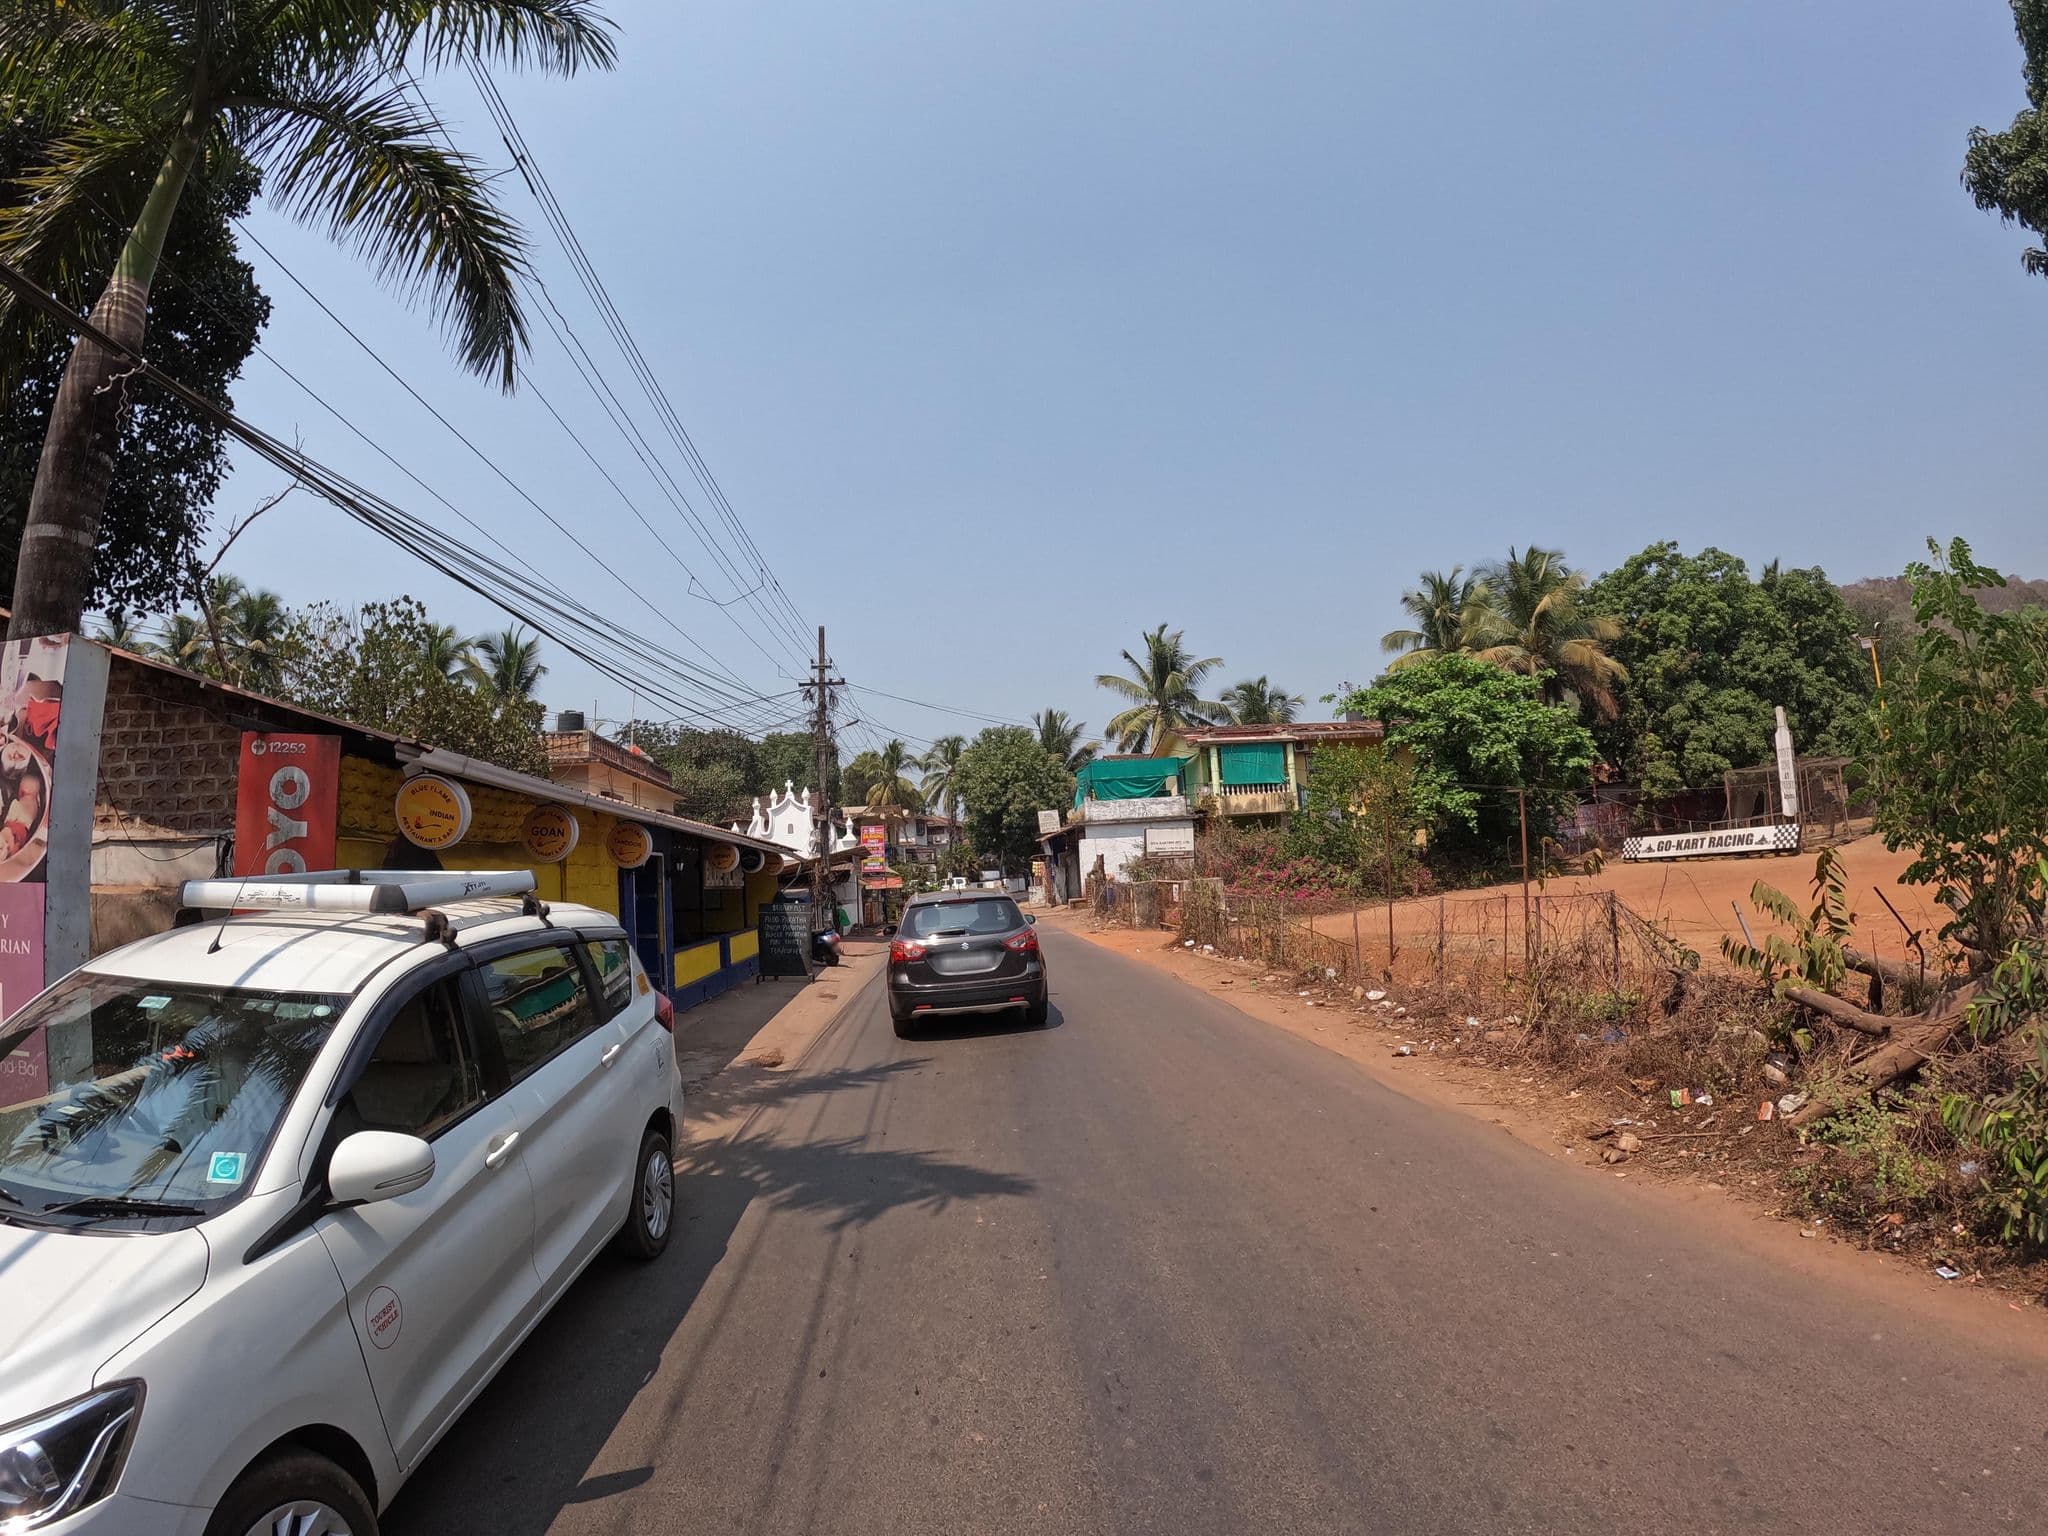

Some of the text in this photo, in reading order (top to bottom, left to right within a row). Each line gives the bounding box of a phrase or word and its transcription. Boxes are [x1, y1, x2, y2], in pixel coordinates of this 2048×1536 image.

[269, 741, 306, 754] 12252
[410, 785, 451, 804] BLUE FLAME
[264, 765, 311, 876] OYO
[429, 809, 455, 821] INDIAN
[402, 816, 437, 844] RESTAURANT
[442, 827, 454, 840] BAR
[531, 826, 565, 838] GOAN
[1656, 833, 1754, 852] GO-KART RACING
[371, 1299, 395, 1327] TOURIST
[374, 1309, 399, 1337] VEHICLE
